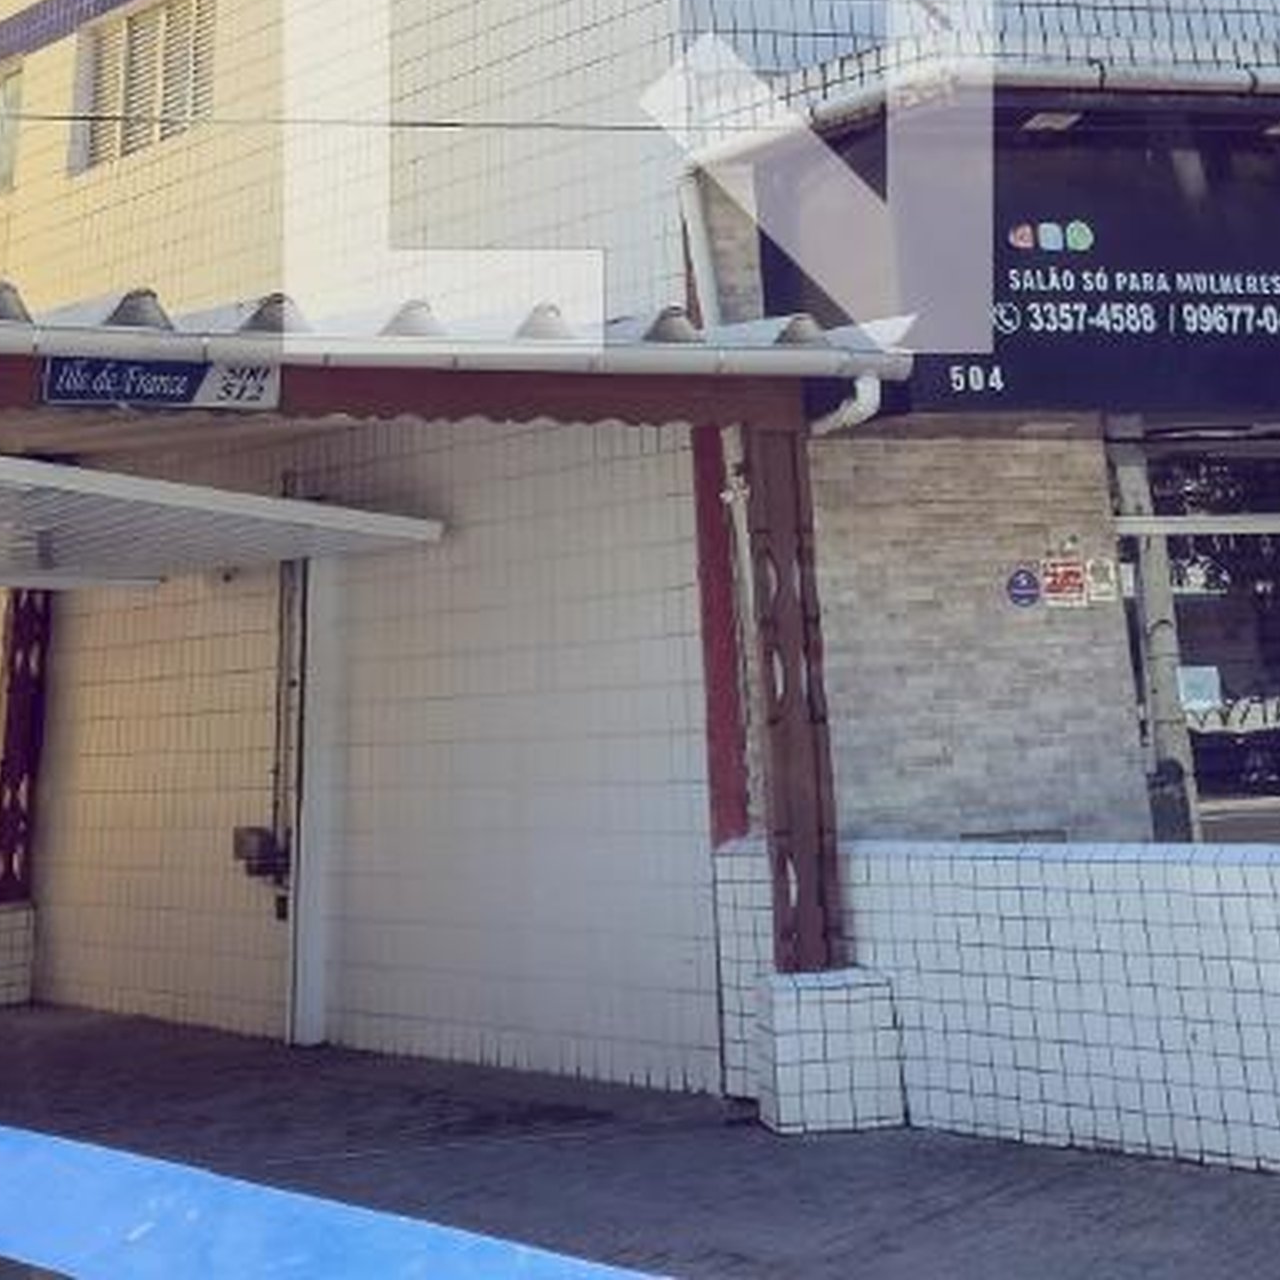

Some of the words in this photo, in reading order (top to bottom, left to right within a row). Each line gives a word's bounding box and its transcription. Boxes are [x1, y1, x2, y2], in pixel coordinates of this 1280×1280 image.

[1008, 266, 1074, 291] SALÃO
[1082, 267, 1109, 291] SÓ
[1116, 271, 1171, 292] PARA
[1029, 303, 1157, 333] 3357-4588
[949, 365, 1005, 392] 504
